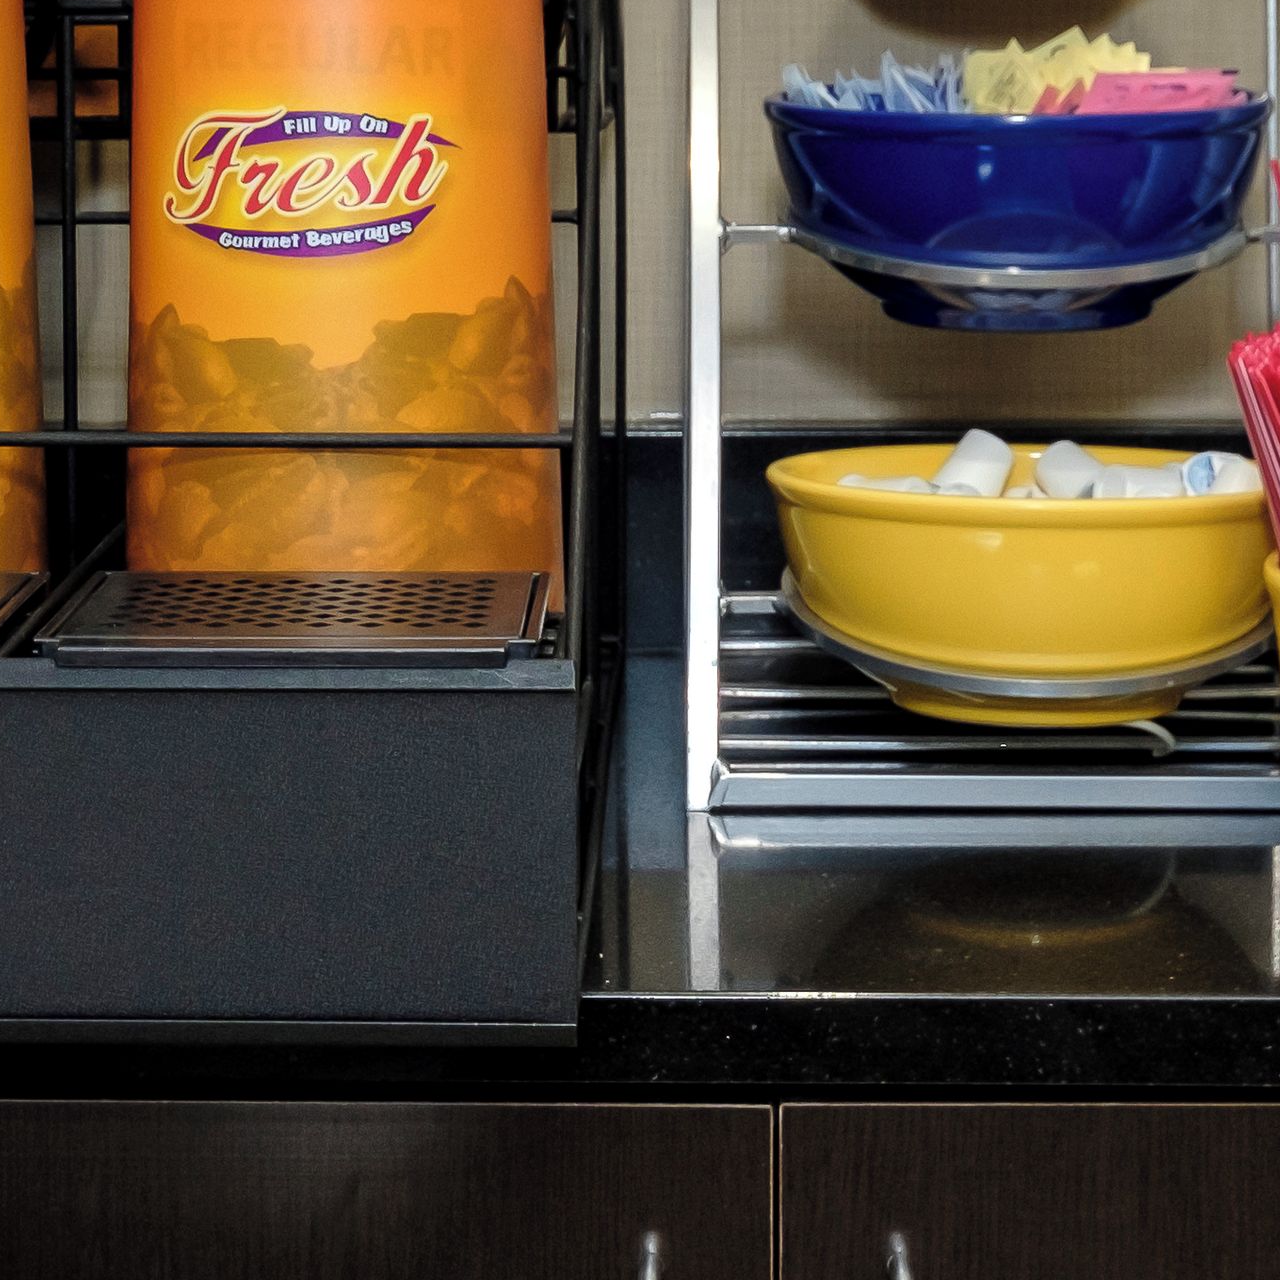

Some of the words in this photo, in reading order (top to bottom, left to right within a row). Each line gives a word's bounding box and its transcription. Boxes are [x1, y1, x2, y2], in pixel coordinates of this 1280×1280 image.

[283, 115, 317, 134] Fill
[323, 115, 351, 134] Up
[361, 114, 388, 134] On
[164, 105, 449, 223] Fresh
[219, 231, 300, 249] Gourmet
[305, 220, 413, 247] Beverages
